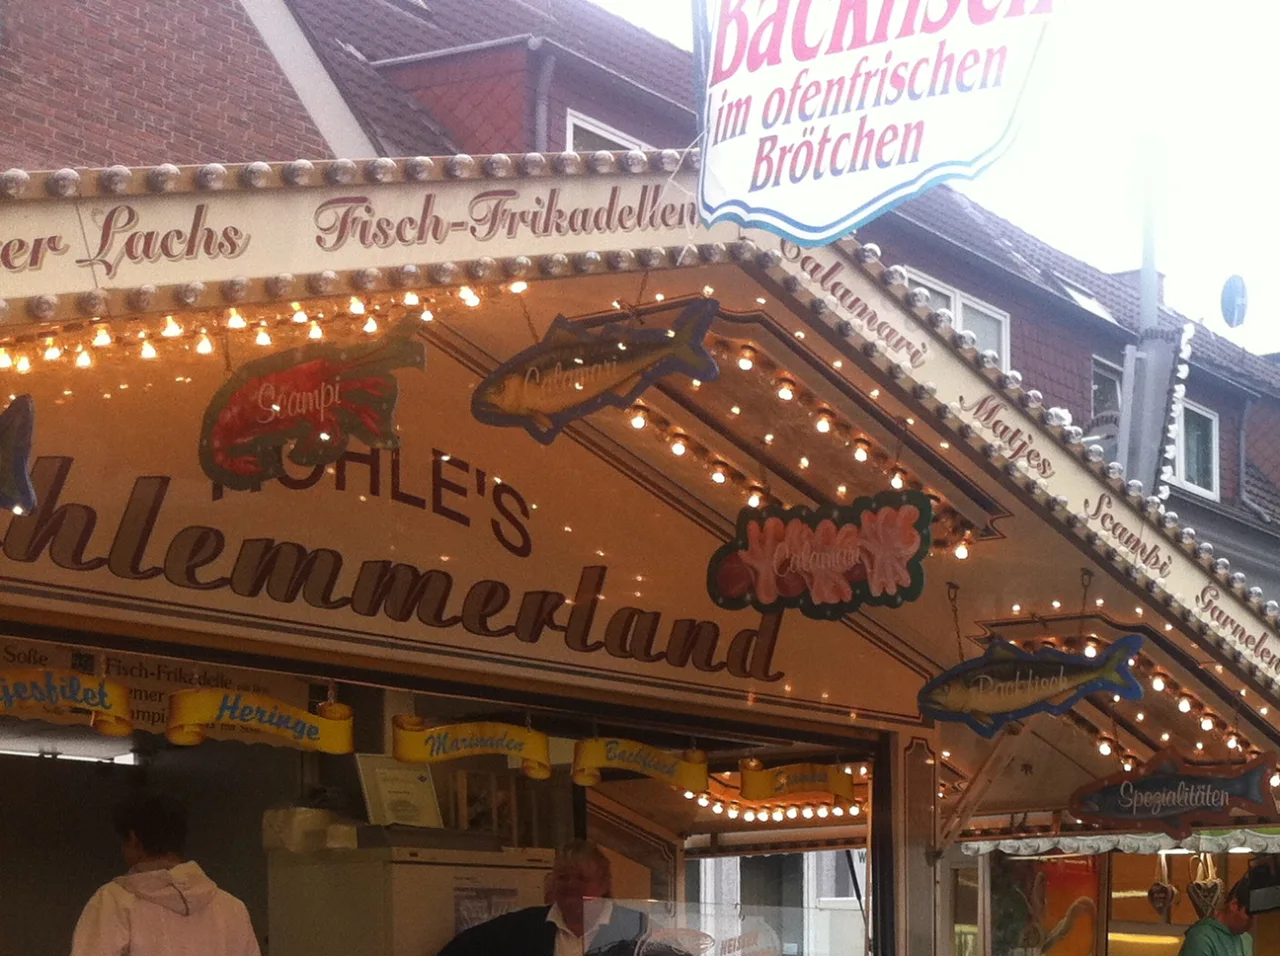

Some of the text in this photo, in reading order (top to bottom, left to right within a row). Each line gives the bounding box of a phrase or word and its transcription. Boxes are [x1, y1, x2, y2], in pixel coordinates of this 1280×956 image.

[711, 39, 1008, 147] im ofenfrischen
[748, 115, 925, 194] Brötchen
[0, 203, 251, 278] er Lachs
[313, 184, 700, 252] Fisch-Frikadellen
[257, 375, 342, 424] Scampi
[958, 393, 1056, 479] Matjes
[212, 440, 533, 559] OHLE'S
[0, 456, 786, 682] hlemmerland
[773, 541, 863, 578] Calamari
[0, 670, 112, 710] jesfilet
[129, 687, 165, 703] mer
[216, 693, 321, 741] Heringe
[1118, 780, 1231, 818] Spezialitäten
